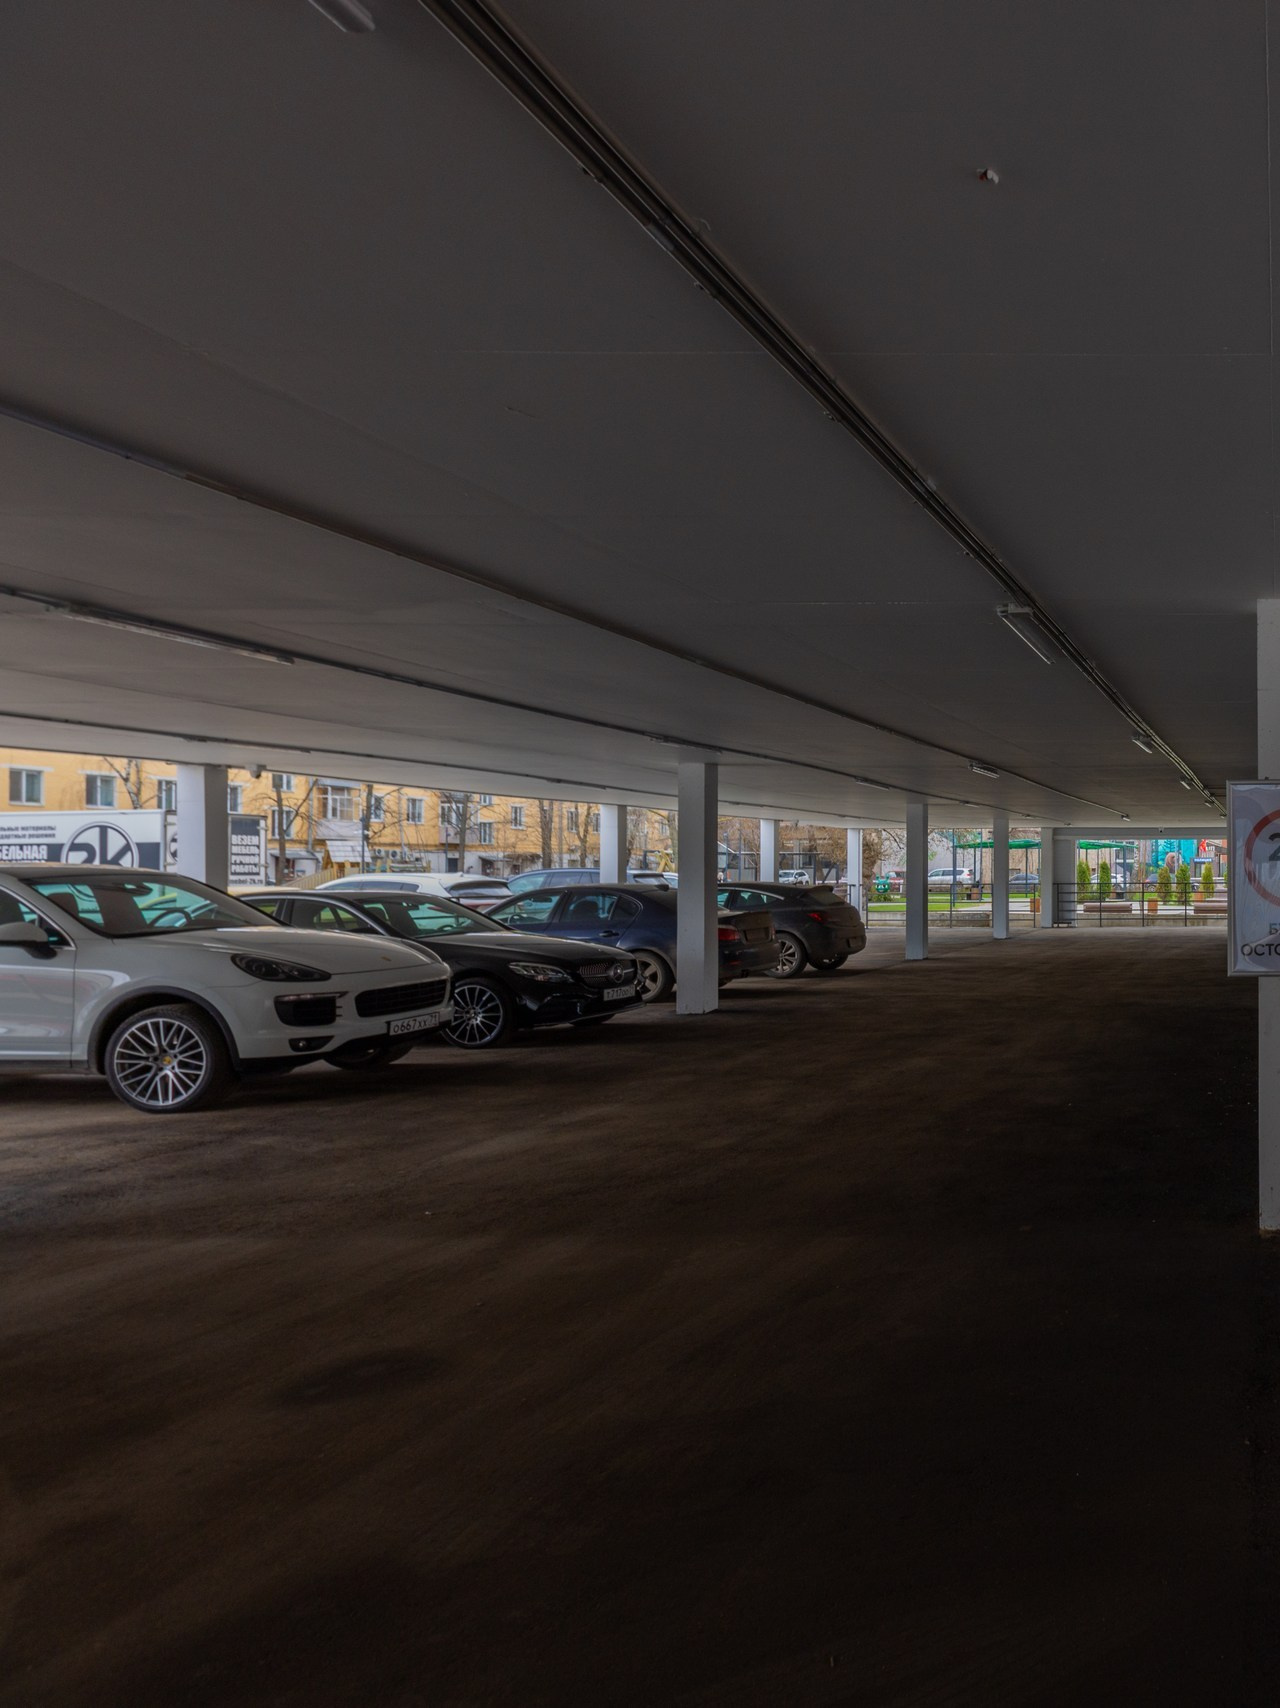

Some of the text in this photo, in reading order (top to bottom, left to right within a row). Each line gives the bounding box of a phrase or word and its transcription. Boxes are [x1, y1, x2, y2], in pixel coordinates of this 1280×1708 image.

[231, 834, 259, 845] ВЕЗЕМ
[0, 844, 48, 860] ЕЛЬНАЯ
[231, 845, 259, 855] МЕБЕЛЬ
[231, 854, 259, 864] РУЧНОЙ
[231, 864, 259, 873] РАБОТЫ
